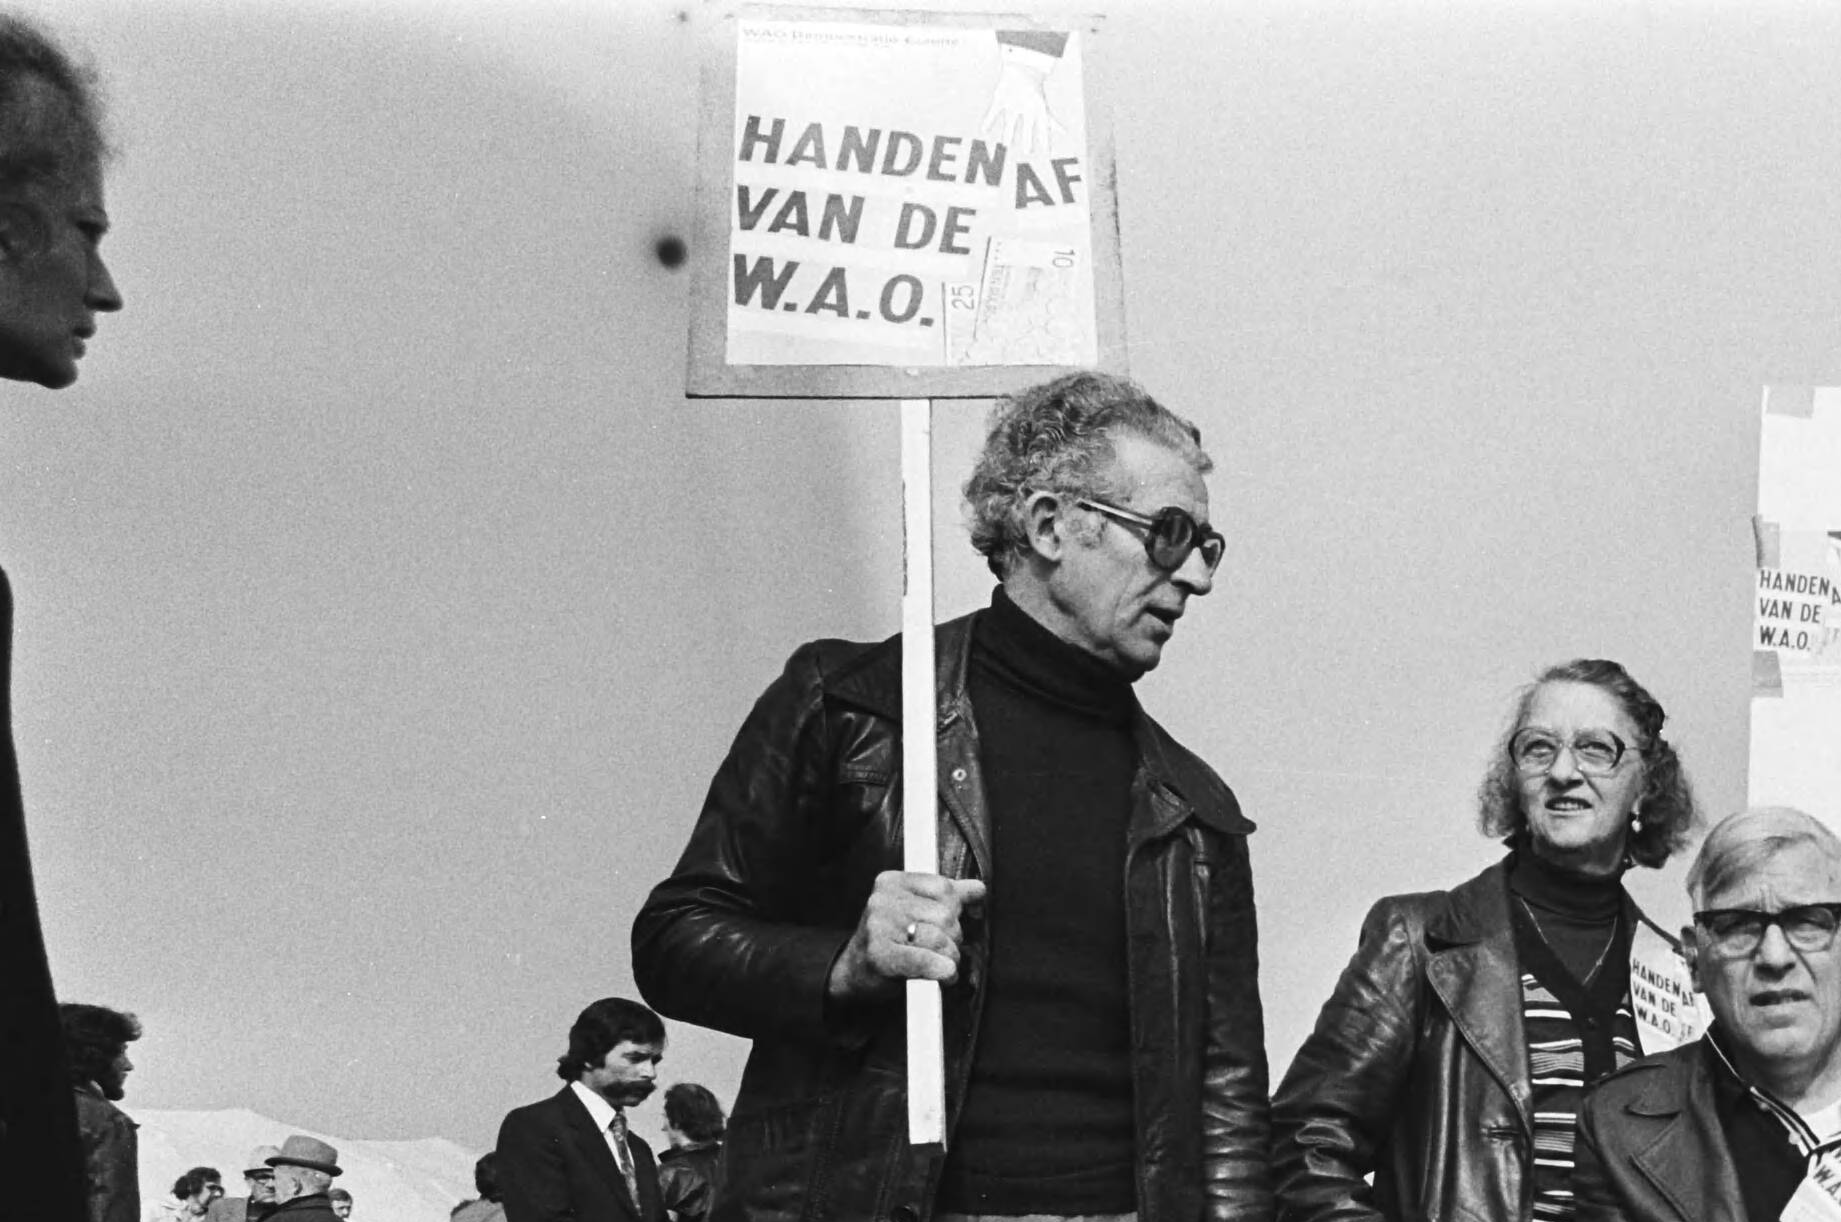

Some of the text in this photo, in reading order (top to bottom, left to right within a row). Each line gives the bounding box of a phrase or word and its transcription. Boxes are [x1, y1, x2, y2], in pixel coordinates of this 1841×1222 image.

[738, 114, 1082, 209] HANDEN AF
[737, 185, 976, 255] VAN DE
[733, 253, 934, 327] W.A.O.
[952, 285, 974, 310] 25
[1759, 569, 1830, 596] HANDEN
[1760, 597, 1822, 624] VAN DE
[1760, 625, 1811, 651] W.A.O.
[1632, 958, 1681, 997] HANDEN
[1633, 981, 1677, 1018] VAN DE
